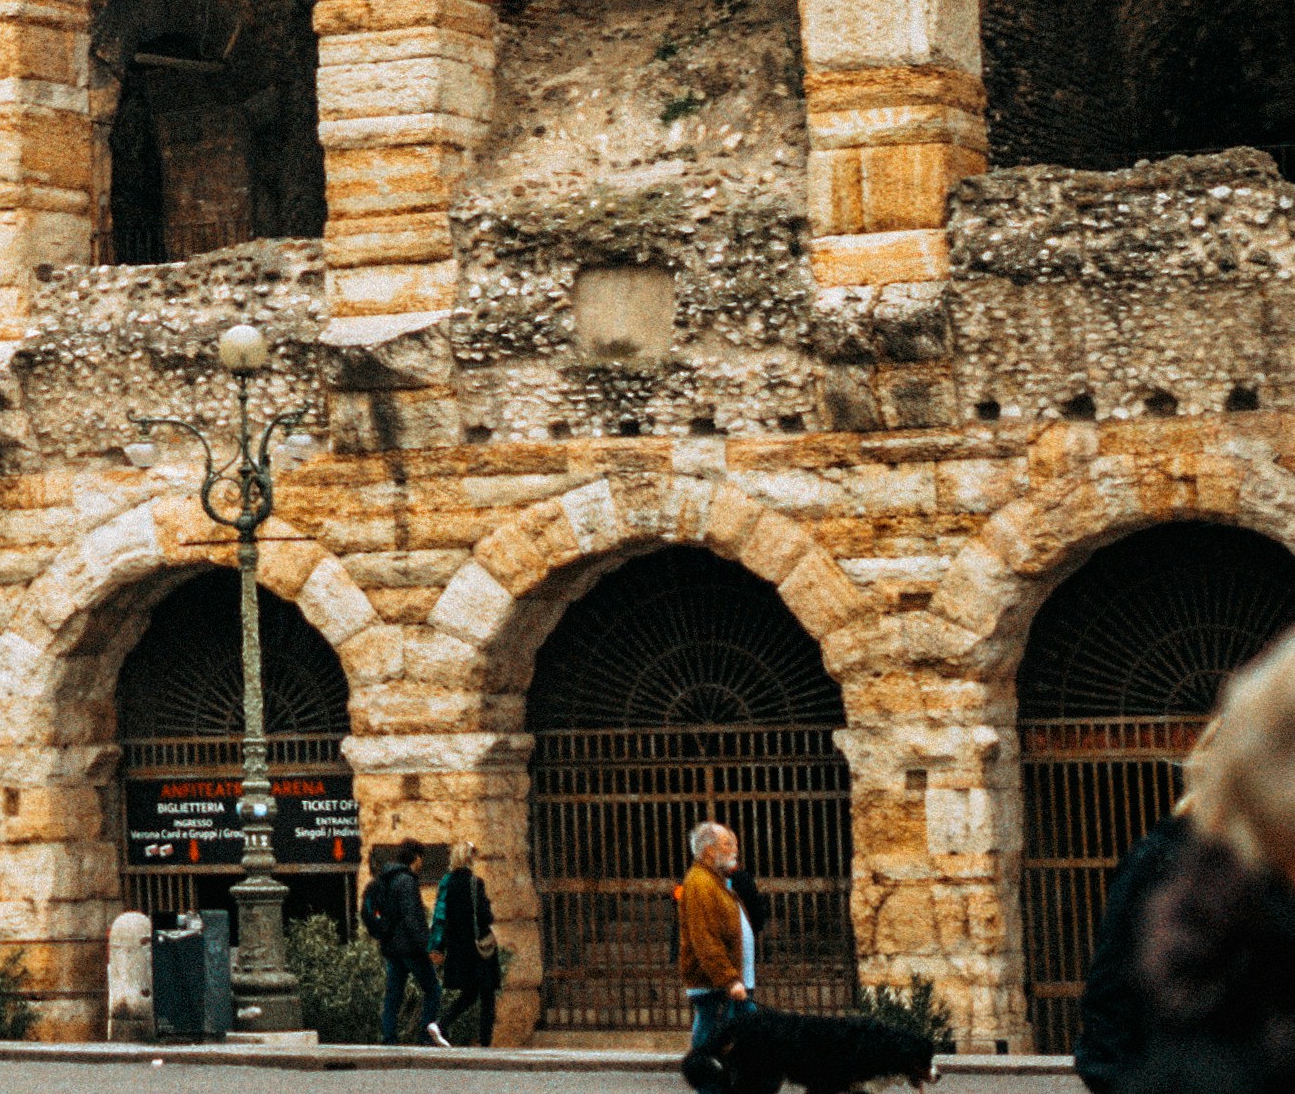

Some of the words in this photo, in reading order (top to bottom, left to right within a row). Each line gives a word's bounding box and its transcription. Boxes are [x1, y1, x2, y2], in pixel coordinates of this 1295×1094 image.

[160, 782, 245, 798] ANFITEATR
[271, 780, 326, 796] ARENA
[157, 802, 225, 814] BIGLIETTERIA
[301, 800, 338, 812] TICKET
[339, 799, 359, 811] OFF
[173, 818, 214, 828] INGRESSO
[161, 828, 181, 840] Card
[188, 829, 218, 842] Gruppi
[294, 827, 326, 841] Singoli
